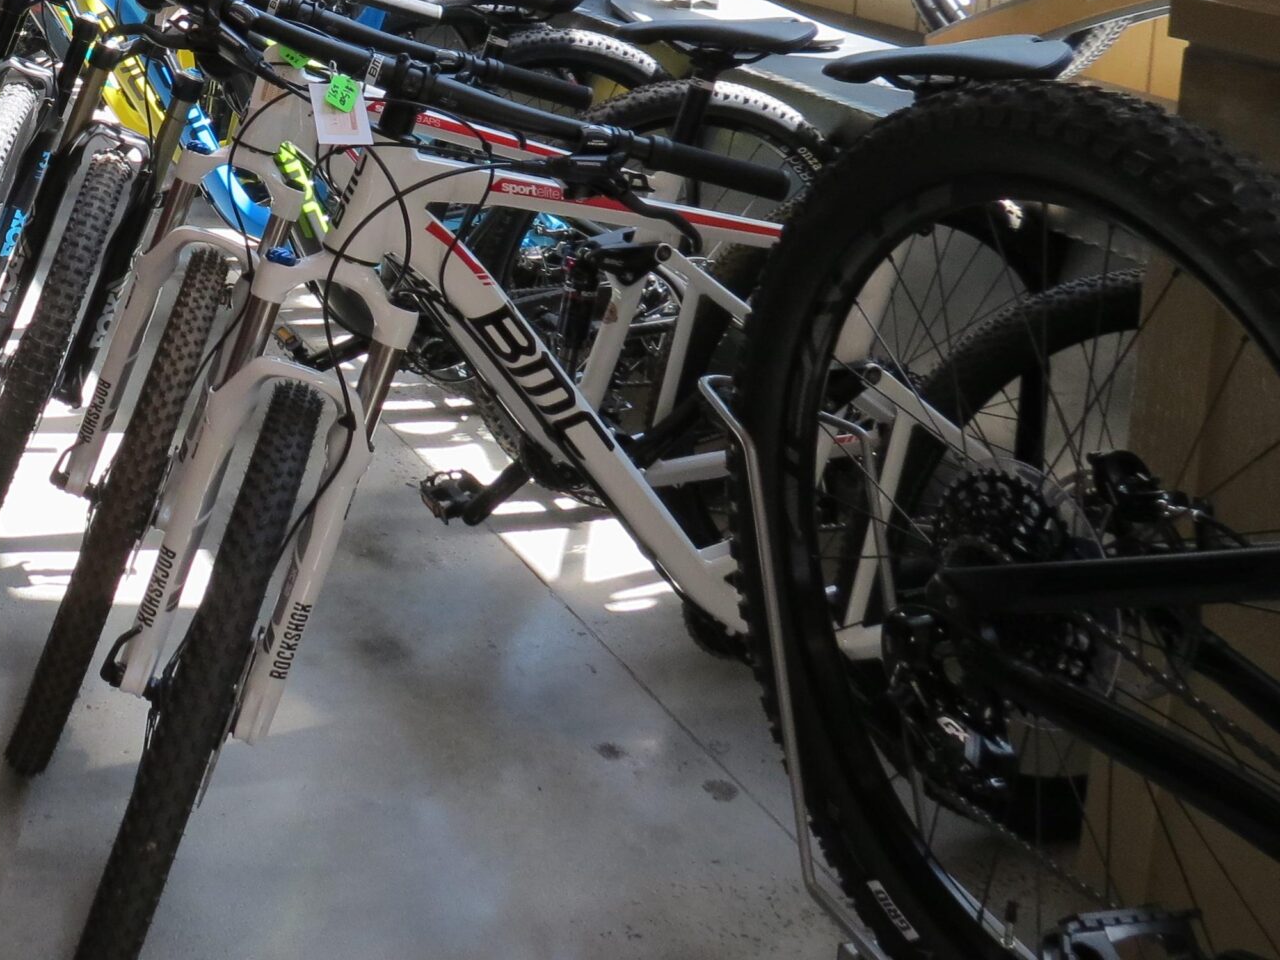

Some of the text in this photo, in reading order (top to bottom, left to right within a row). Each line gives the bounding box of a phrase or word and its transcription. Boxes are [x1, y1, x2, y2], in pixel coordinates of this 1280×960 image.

[422, 116, 441, 128] APS
[798, 146, 823, 171] onza
[500, 181, 561, 200] sportelite
[0, 209, 28, 257] FOX
[466, 303, 616, 461] BMC
[78, 377, 112, 444] ROCKSHOX
[138, 545, 176, 628] ROCKSHOX
[269, 601, 312, 680] ROCKSHOX
[878, 891, 911, 933] GRID
